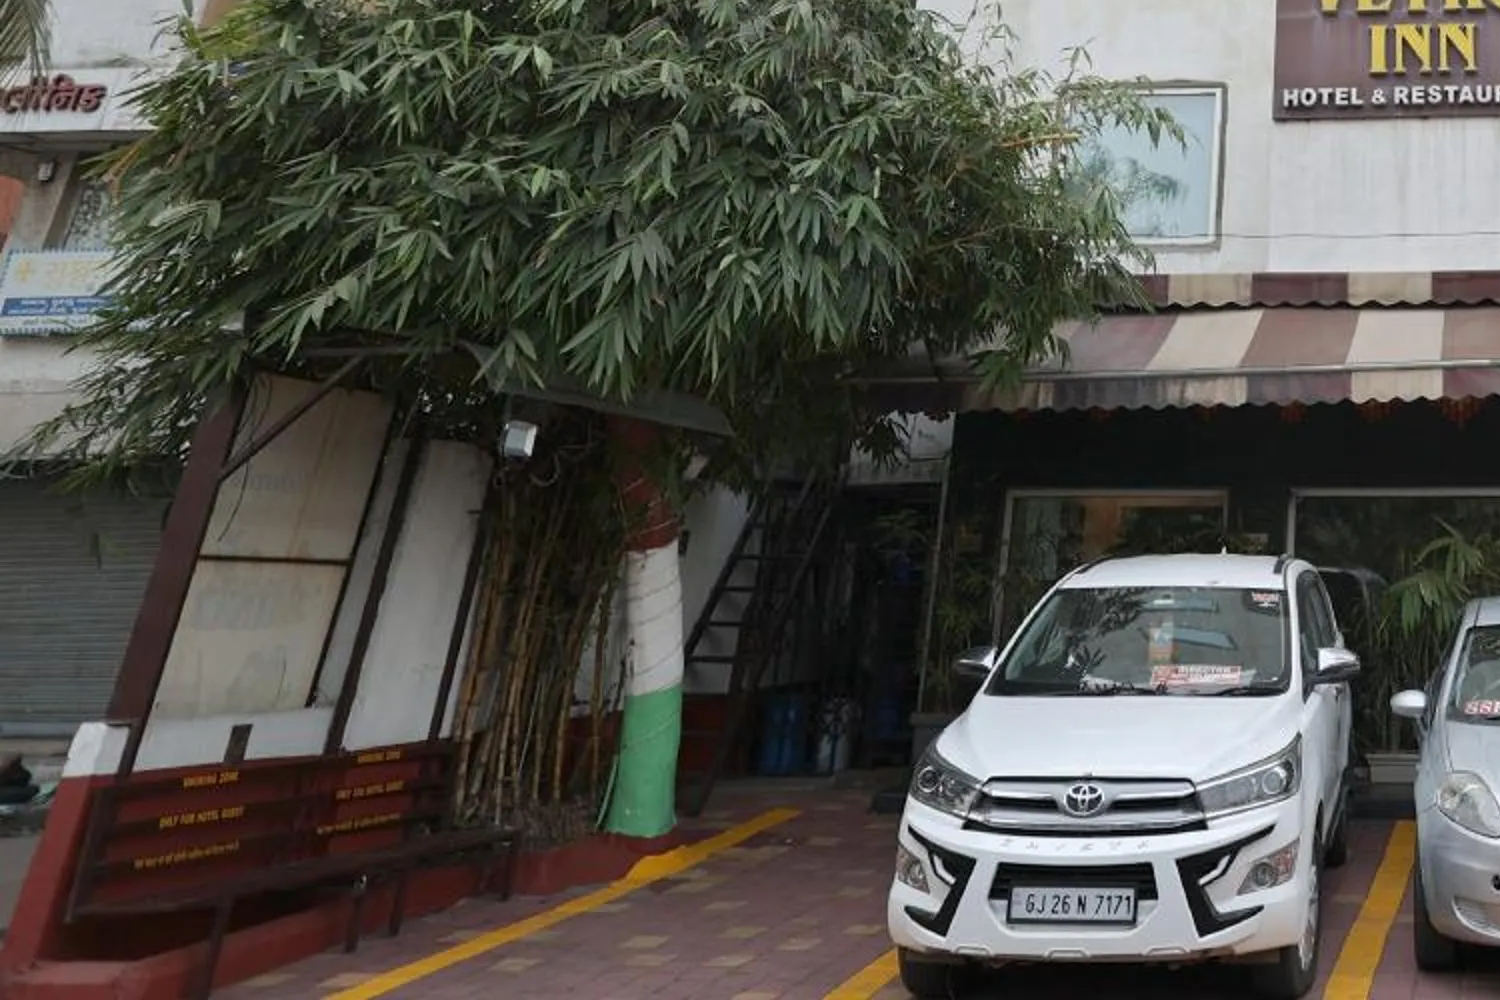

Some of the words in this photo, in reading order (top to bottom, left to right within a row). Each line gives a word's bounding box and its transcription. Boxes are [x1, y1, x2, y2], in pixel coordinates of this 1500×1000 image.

[1368, 22, 1478, 75] INN
[1282, 87, 1363, 107] HOTEL
[1371, 89, 1385, 105] &
[1025, 893, 1045, 915] GJ
[1051, 894, 1071, 915] 26
[1077, 895, 1087, 915] N
[1095, 895, 1131, 915] 7171
